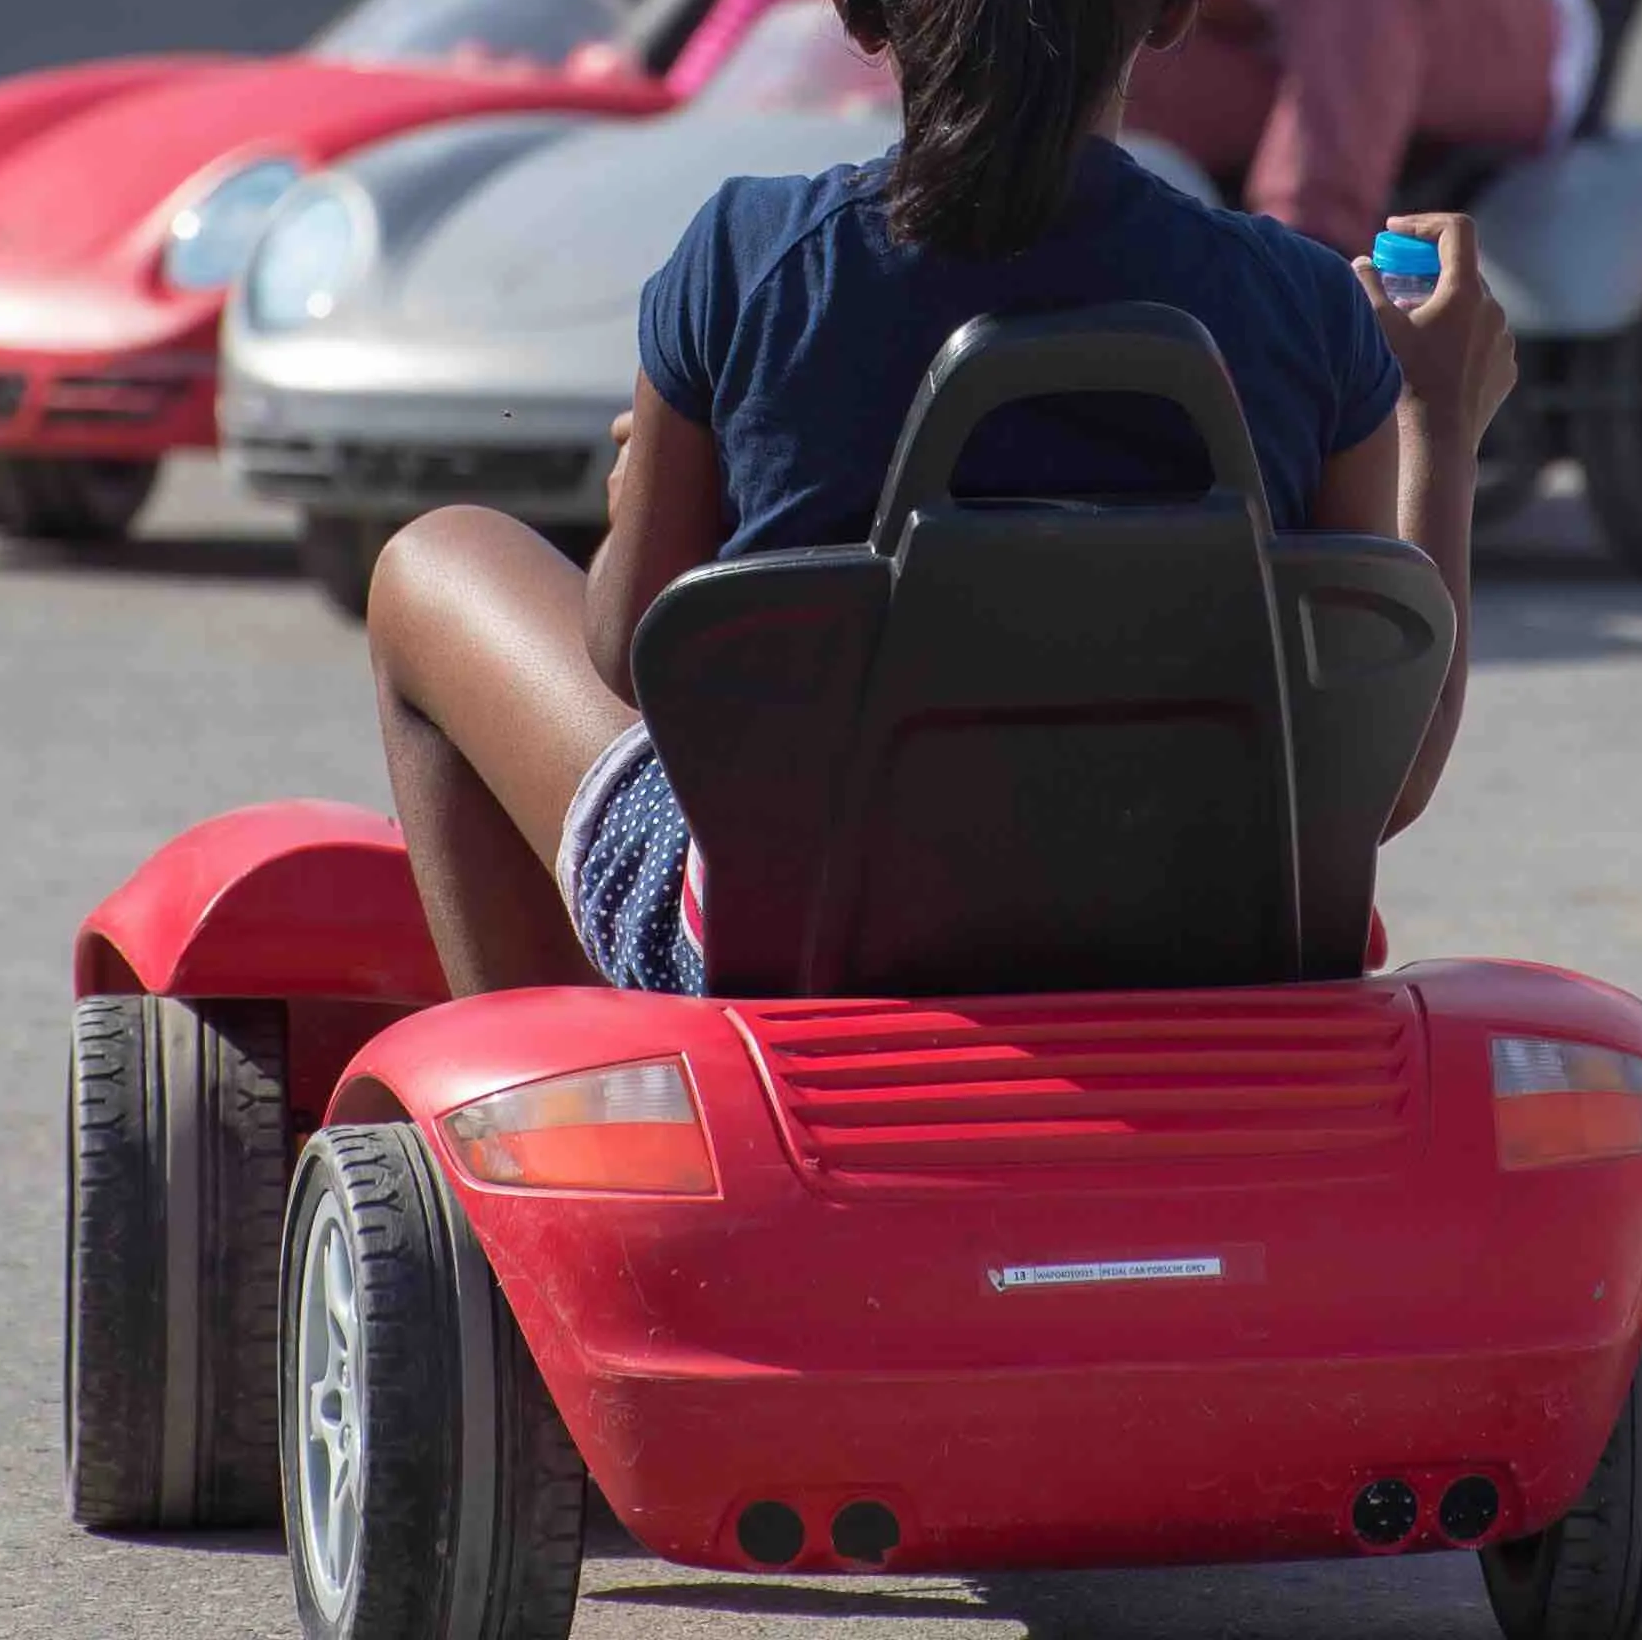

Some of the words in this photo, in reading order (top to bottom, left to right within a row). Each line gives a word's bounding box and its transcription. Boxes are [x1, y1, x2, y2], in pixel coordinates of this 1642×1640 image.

[1102, 1267, 1127, 1277] PEDAL
[1128, 1266, 1145, 1275] CAR
[1147, 1265, 1184, 1275] PORSCHE
